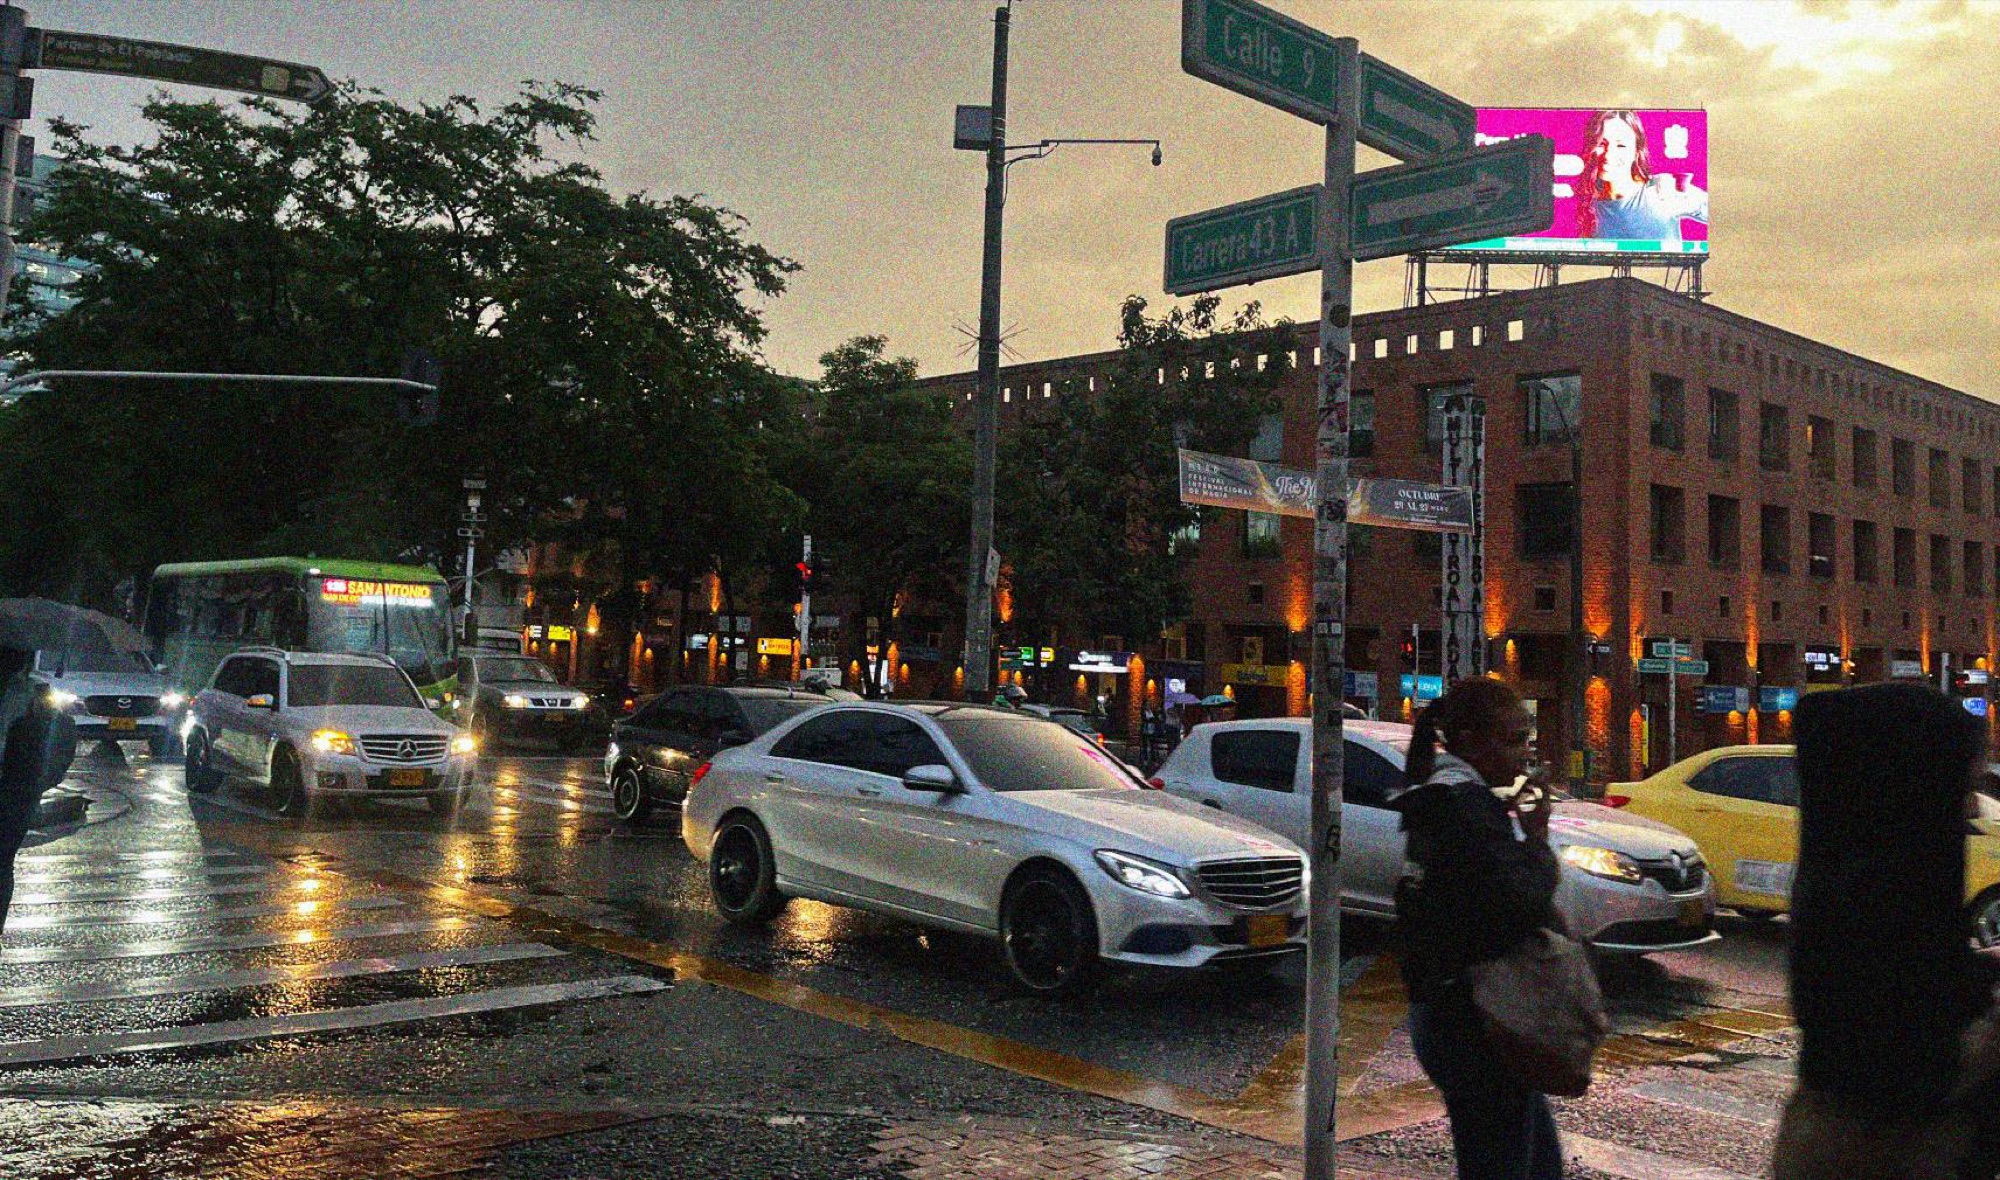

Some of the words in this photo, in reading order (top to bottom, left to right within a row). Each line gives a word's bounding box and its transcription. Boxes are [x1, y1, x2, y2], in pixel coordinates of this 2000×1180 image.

[1223, 16, 1283, 77] Calle
[1302, 48, 1316, 88] 9
[1251, 216, 1276, 254] 43
[1284, 211, 1299, 248] A
[1187, 480, 1254, 496] INTERNACIONAL
[1202, 489, 1229, 499] MAGIA
[1275, 475, 1300, 498] The
[348, 581, 375, 595] SAN
[375, 583, 431, 598] ANTONIO
